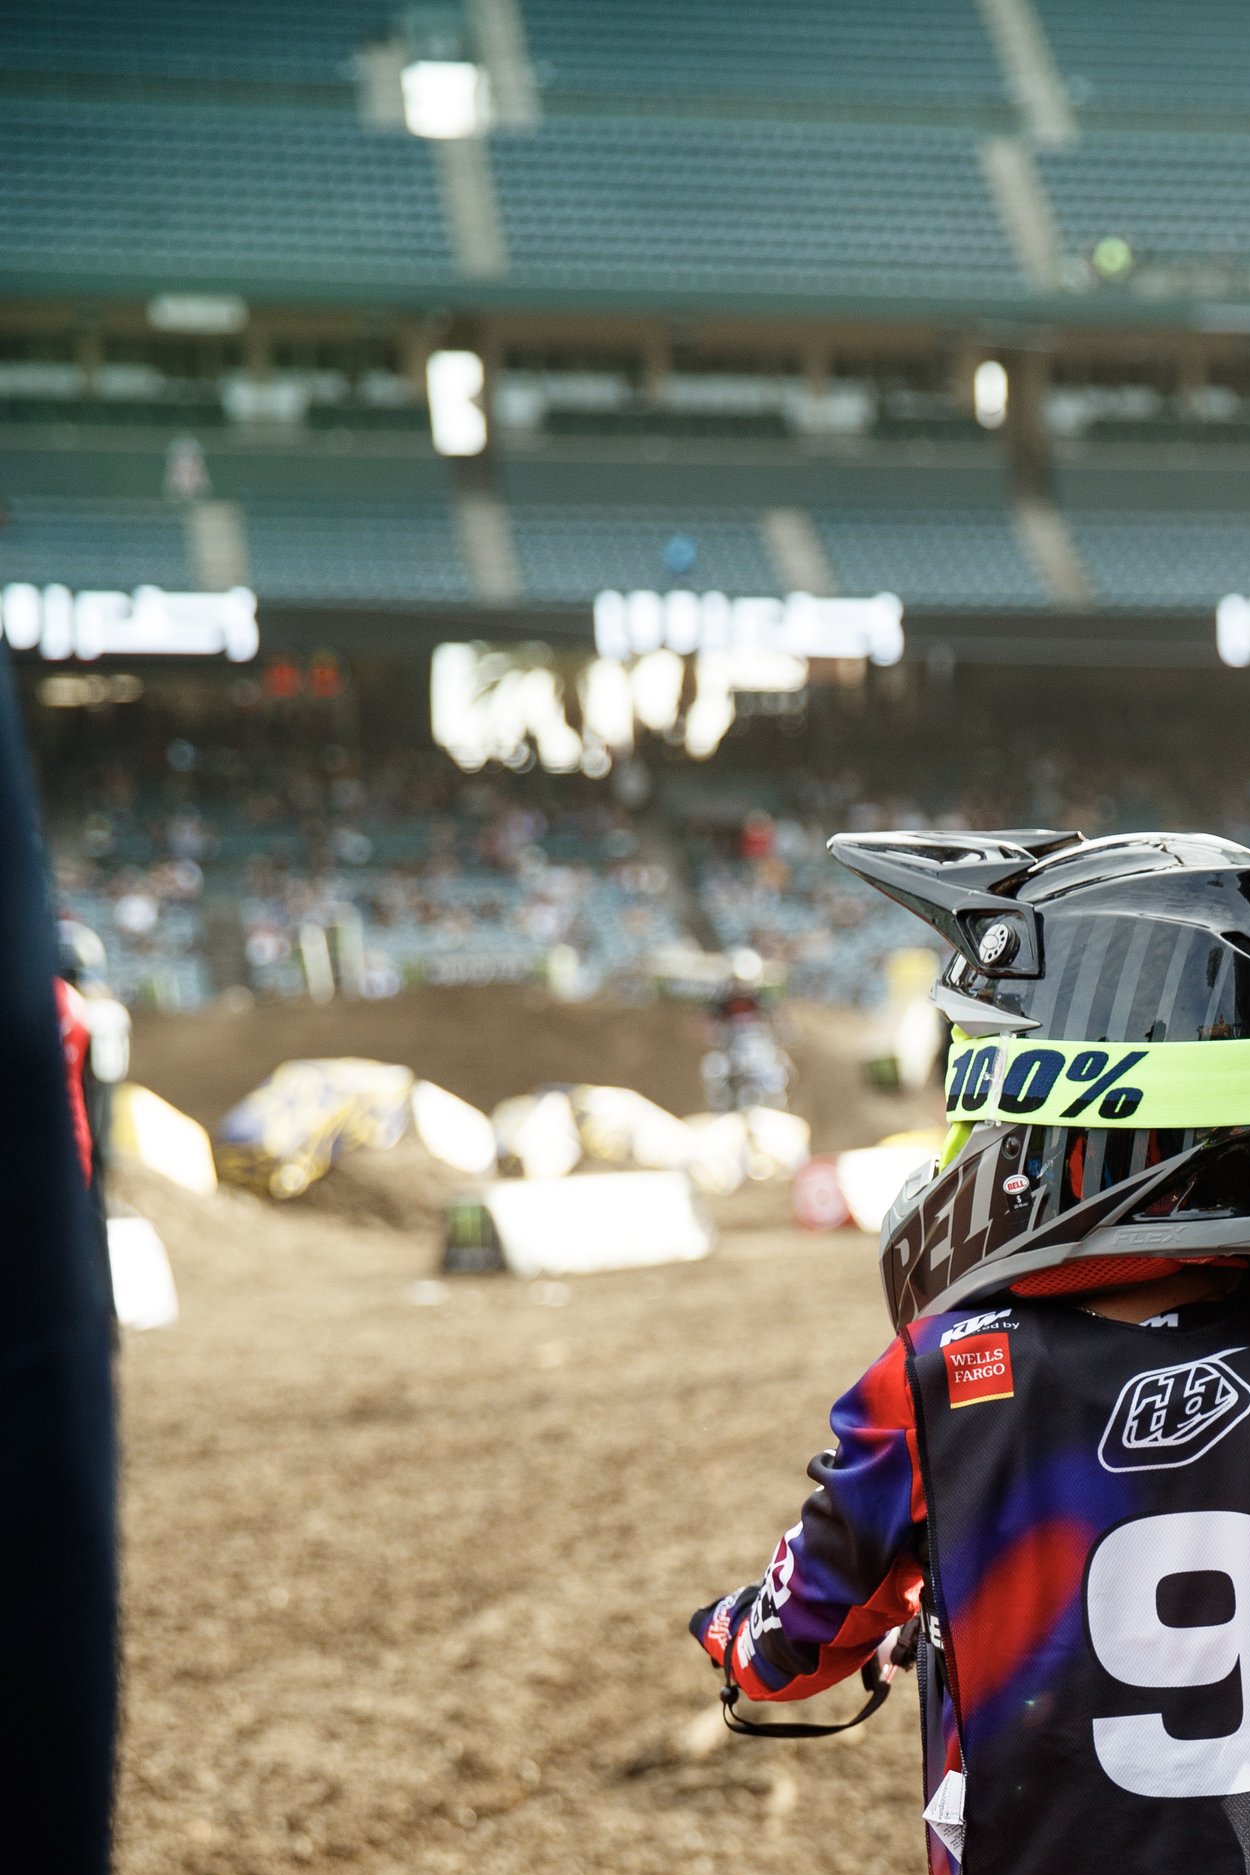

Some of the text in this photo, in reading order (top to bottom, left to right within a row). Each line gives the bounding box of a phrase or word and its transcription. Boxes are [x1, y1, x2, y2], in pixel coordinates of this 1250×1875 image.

[946, 1045, 1150, 1120] 100%
[1007, 1180, 1025, 1191] BELL
[1016, 1195, 1022, 1203] S
[1112, 1225, 1187, 1246] FLEX
[940, 1308, 1013, 1348] KTM
[1003, 1321, 1020, 1330] by
[950, 1348, 1004, 1367] WELLS
[954, 1363, 1005, 1383] FARGO
